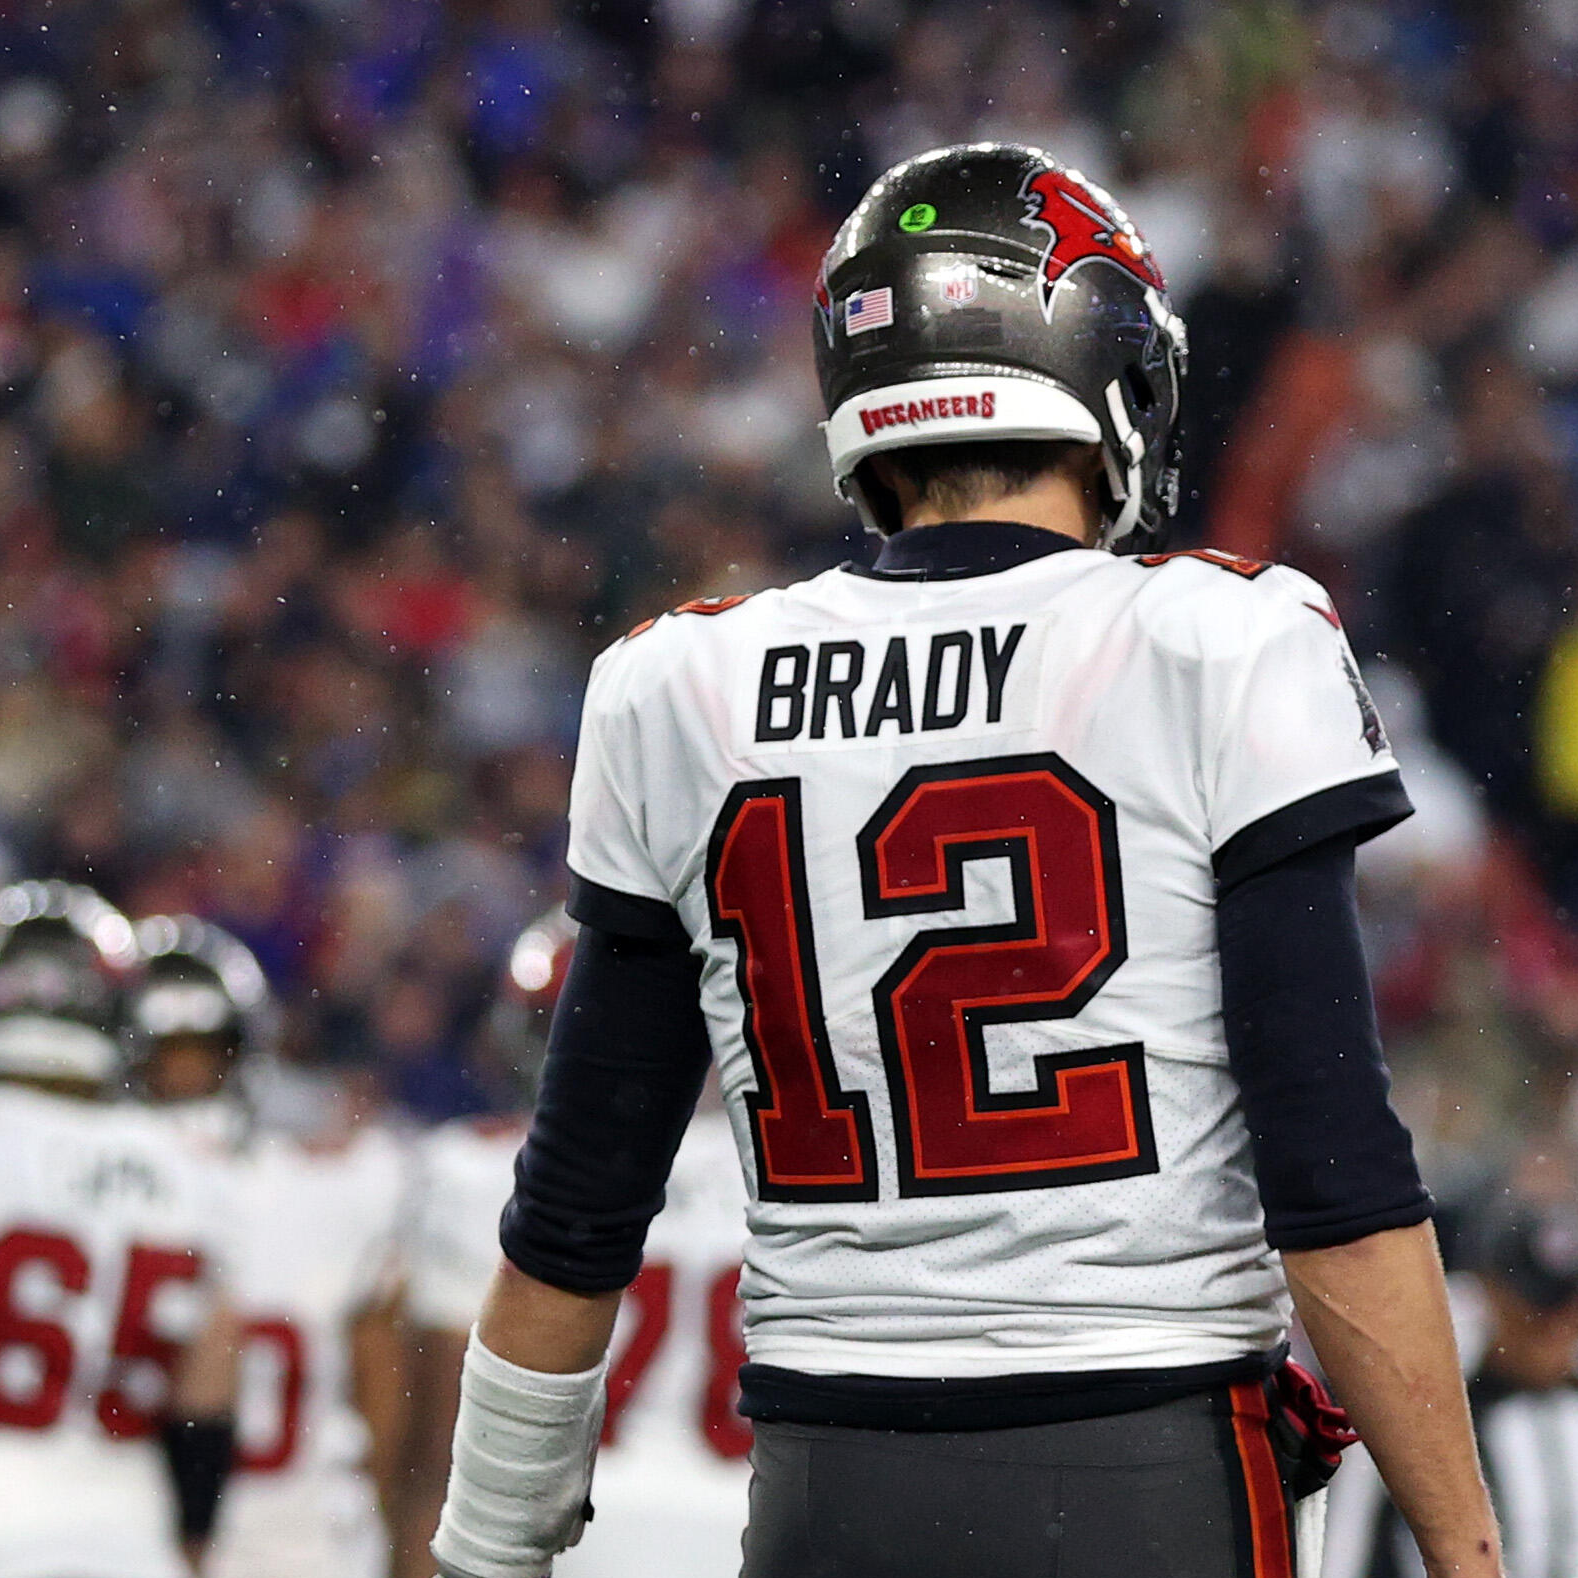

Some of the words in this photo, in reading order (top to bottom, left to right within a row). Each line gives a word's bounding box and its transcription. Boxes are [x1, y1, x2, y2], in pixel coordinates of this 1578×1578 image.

[859, 391, 996, 436] BUCCANEERS
[753, 622, 1027, 744] BRADY
[705, 751, 1161, 1202] 12
